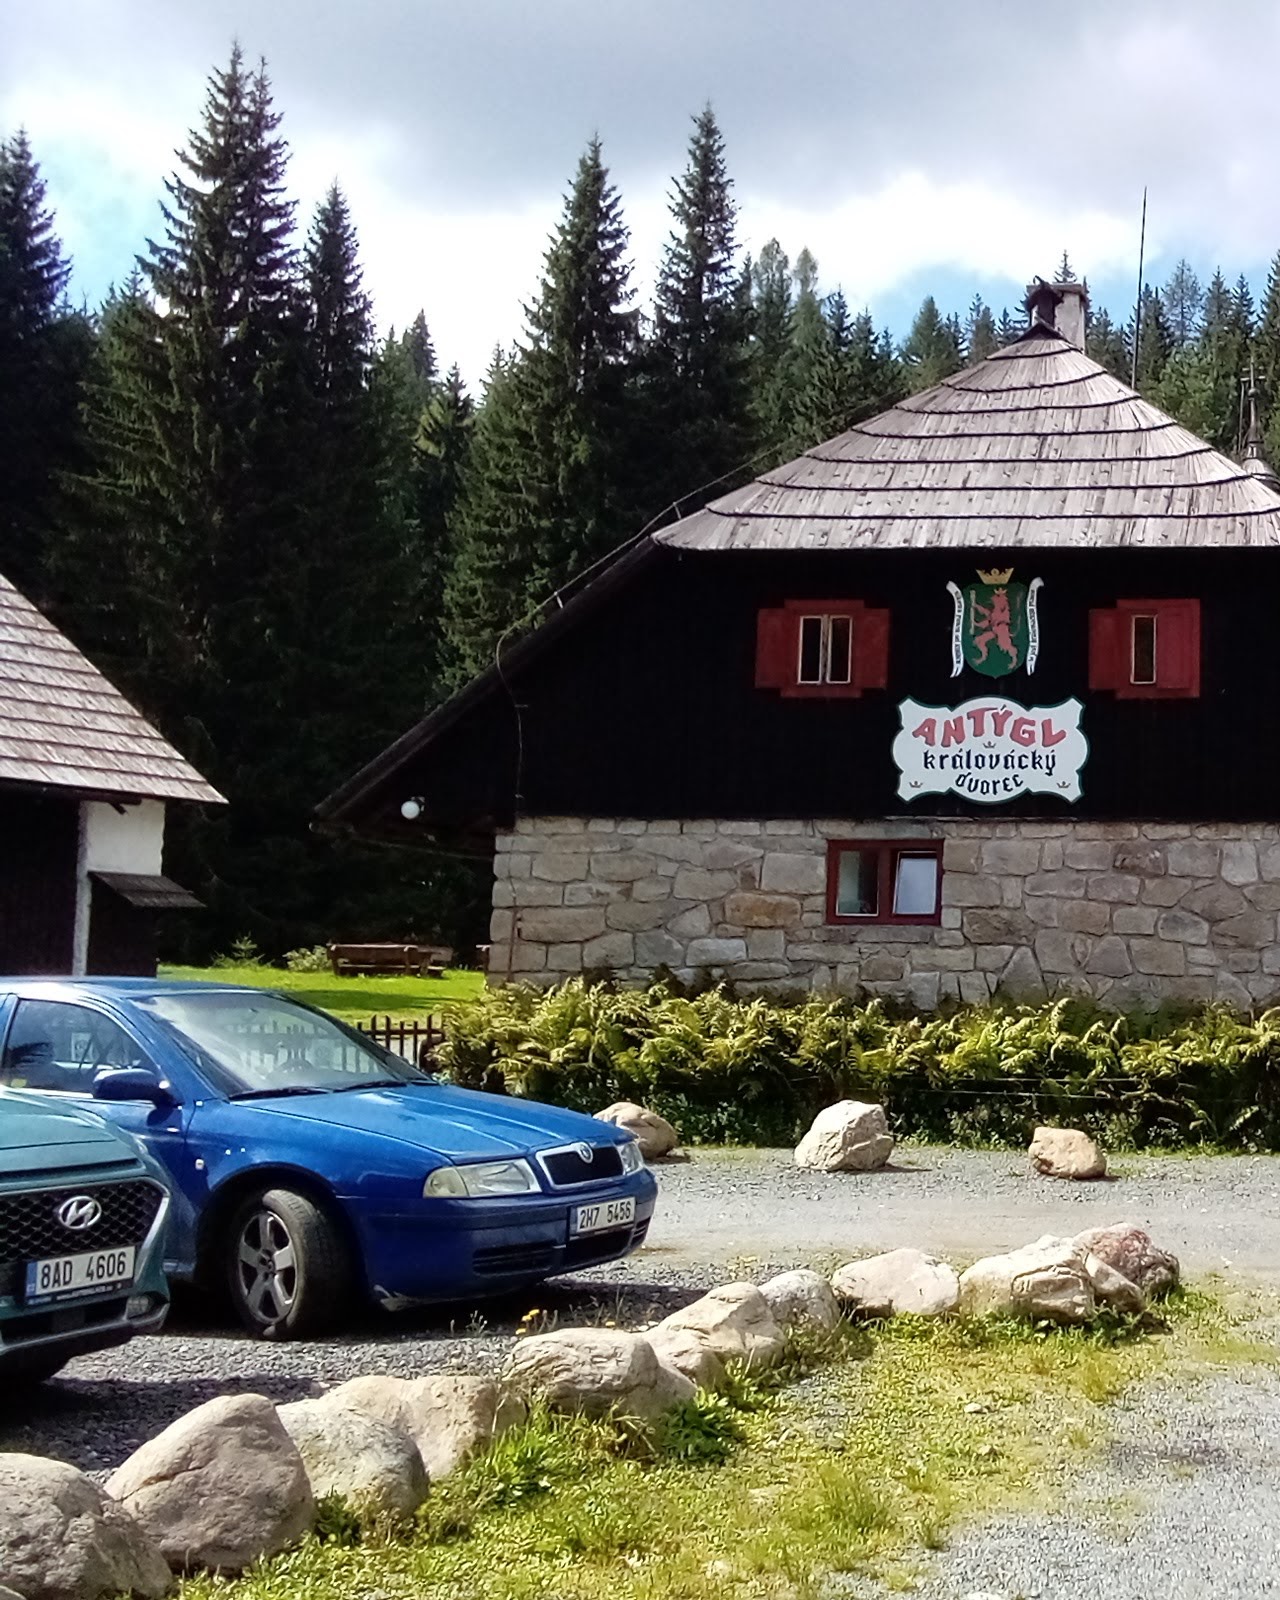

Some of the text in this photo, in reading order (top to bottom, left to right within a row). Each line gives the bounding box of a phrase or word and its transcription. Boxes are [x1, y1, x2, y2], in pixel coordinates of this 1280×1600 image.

[923, 748, 1056, 777] královácký
[956, 771, 1024, 796] dvorec
[580, 1200, 631, 1229] 2H7 5456
[41, 1251, 127, 1289] 8AD 4606
